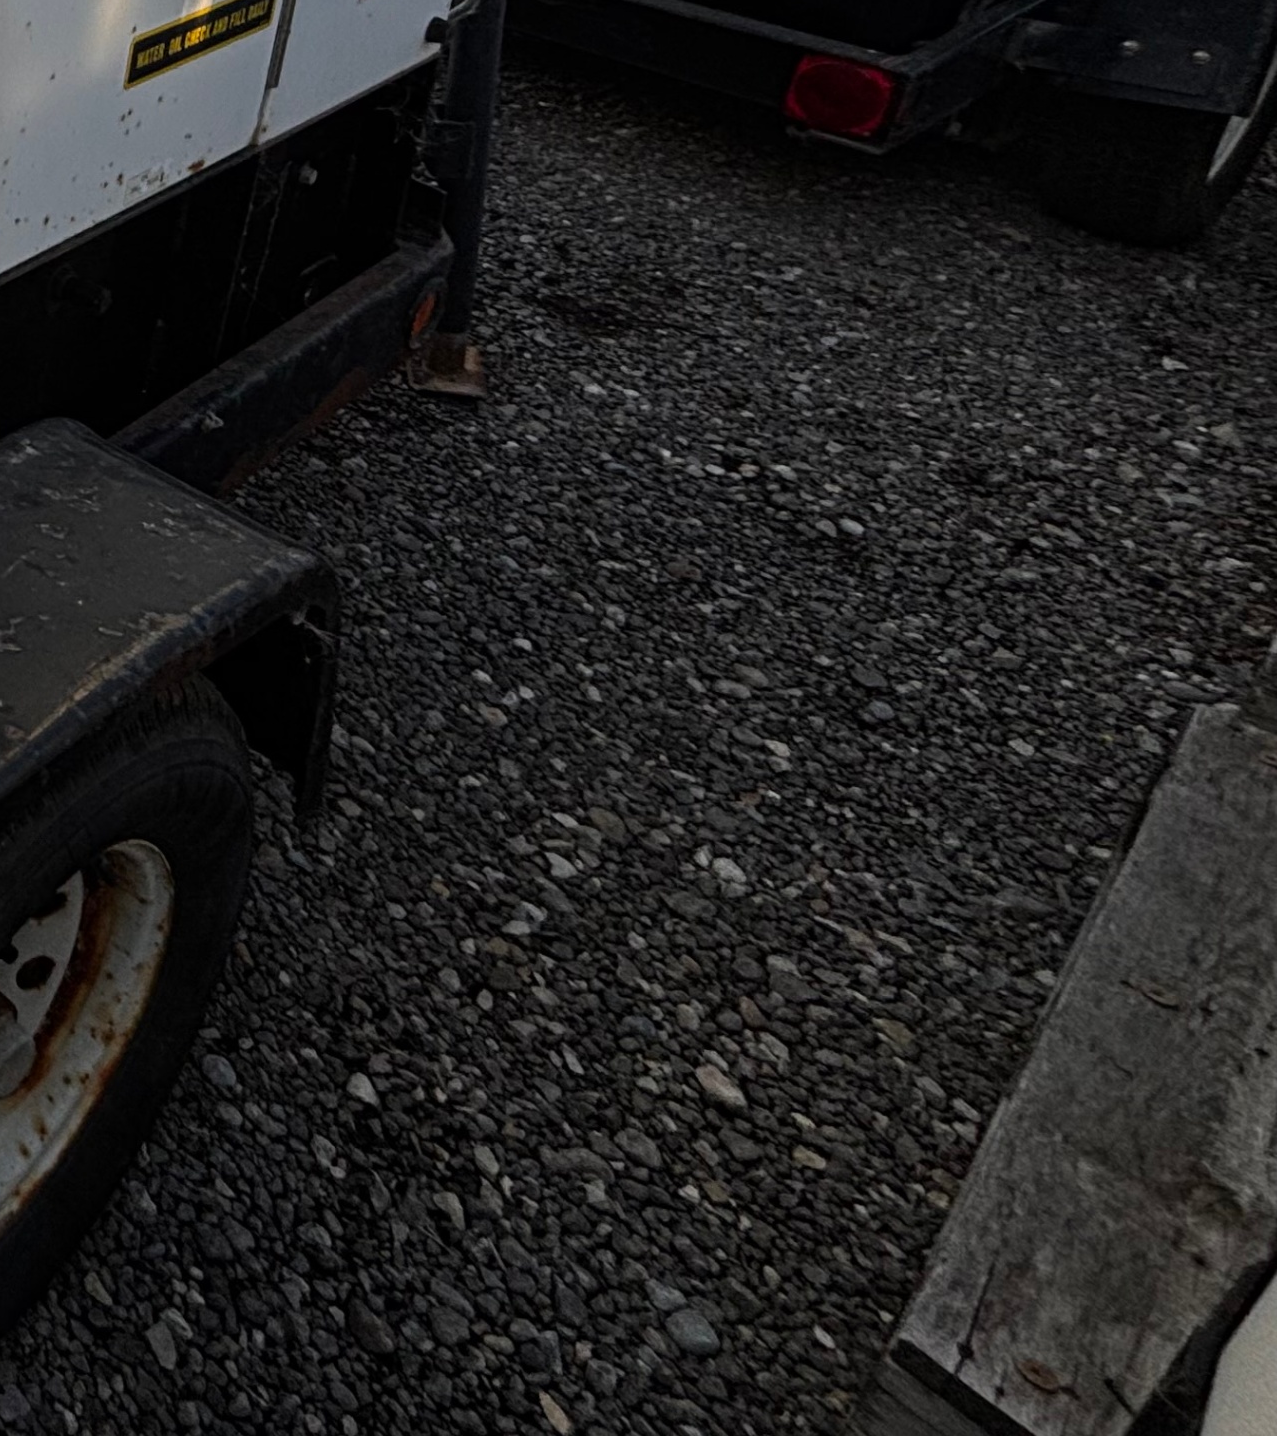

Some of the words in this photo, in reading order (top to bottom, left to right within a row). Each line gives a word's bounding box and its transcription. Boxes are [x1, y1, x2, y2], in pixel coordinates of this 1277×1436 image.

[135, 42, 166, 69] WATER
[168, 35, 183, 55] OIL
[184, 25, 211, 49] CHECK
[211, 16, 229, 37] AND
[230, 8, 247, 30] FILL
